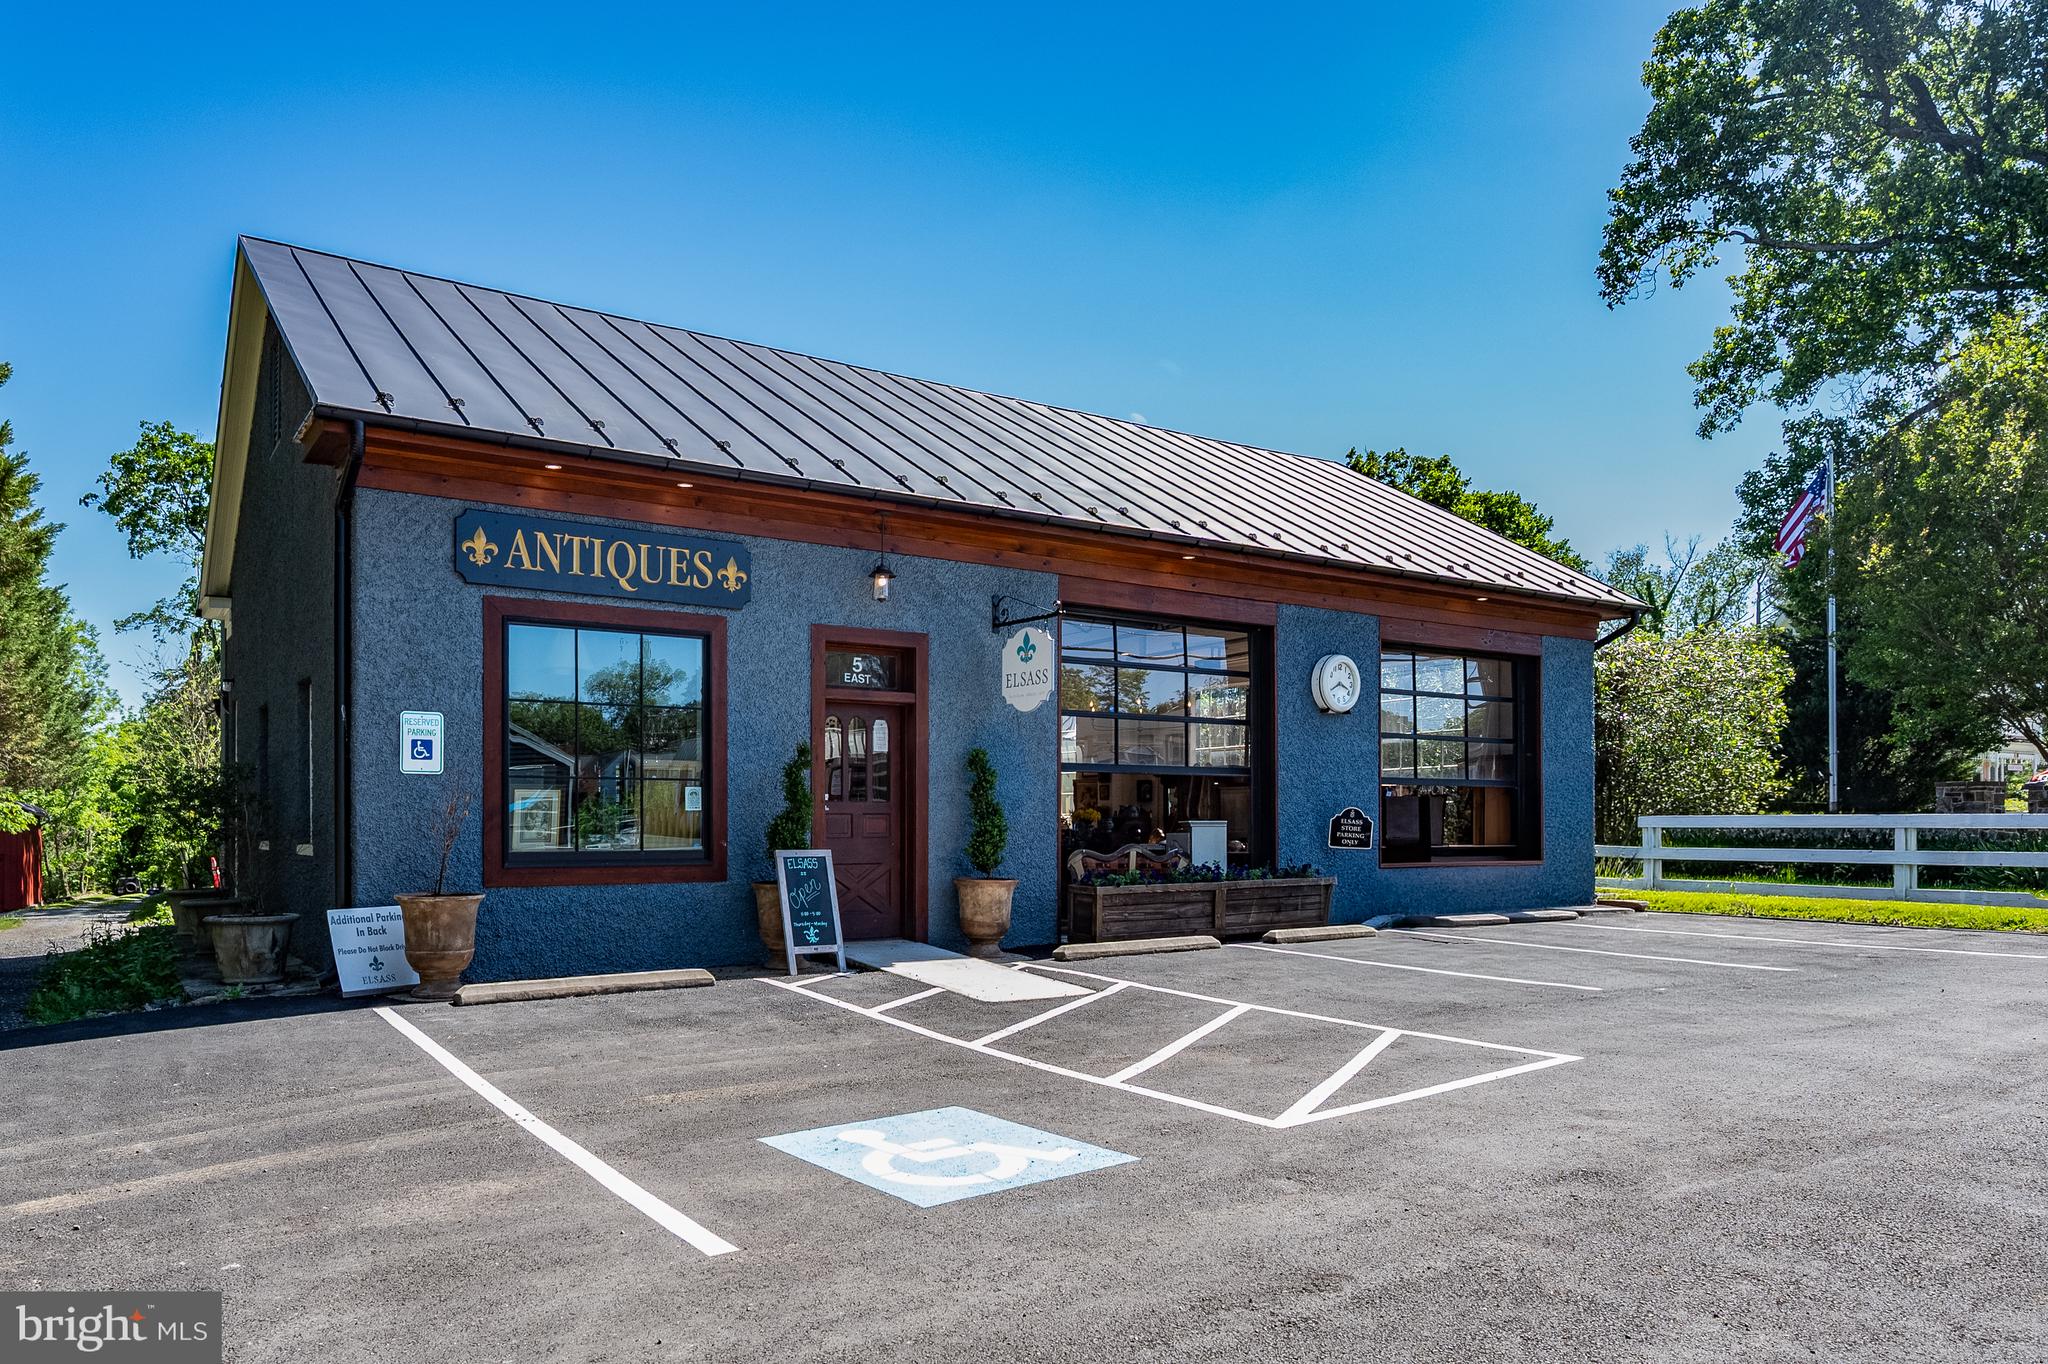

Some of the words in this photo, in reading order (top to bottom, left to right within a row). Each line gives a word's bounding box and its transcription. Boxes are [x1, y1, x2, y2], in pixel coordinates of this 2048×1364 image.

[504, 529, 713, 592] ANTIQUES
[852, 657, 863, 672] 5
[844, 672, 871, 684] EAST
[1005, 668, 1049, 689] ELSASS
[404, 718, 440, 727] RESERVED
[407, 728, 437, 737] PARKING
[1336, 831, 1365, 839] PARKING
[787, 857, 819, 870] ELSASS
[788, 878, 821, 909] Open
[330, 913, 374, 926] Additional
[375, 911, 403, 923] Parkin
[356, 927, 366, 937] In
[367, 925, 388, 936] Back
[337, 947, 357, 956] Please
[358, 945, 367, 954] Do
[367, 944, 379, 953] Not
[379, 943, 395, 951] Block
[361, 973, 397, 985] ELSASS
